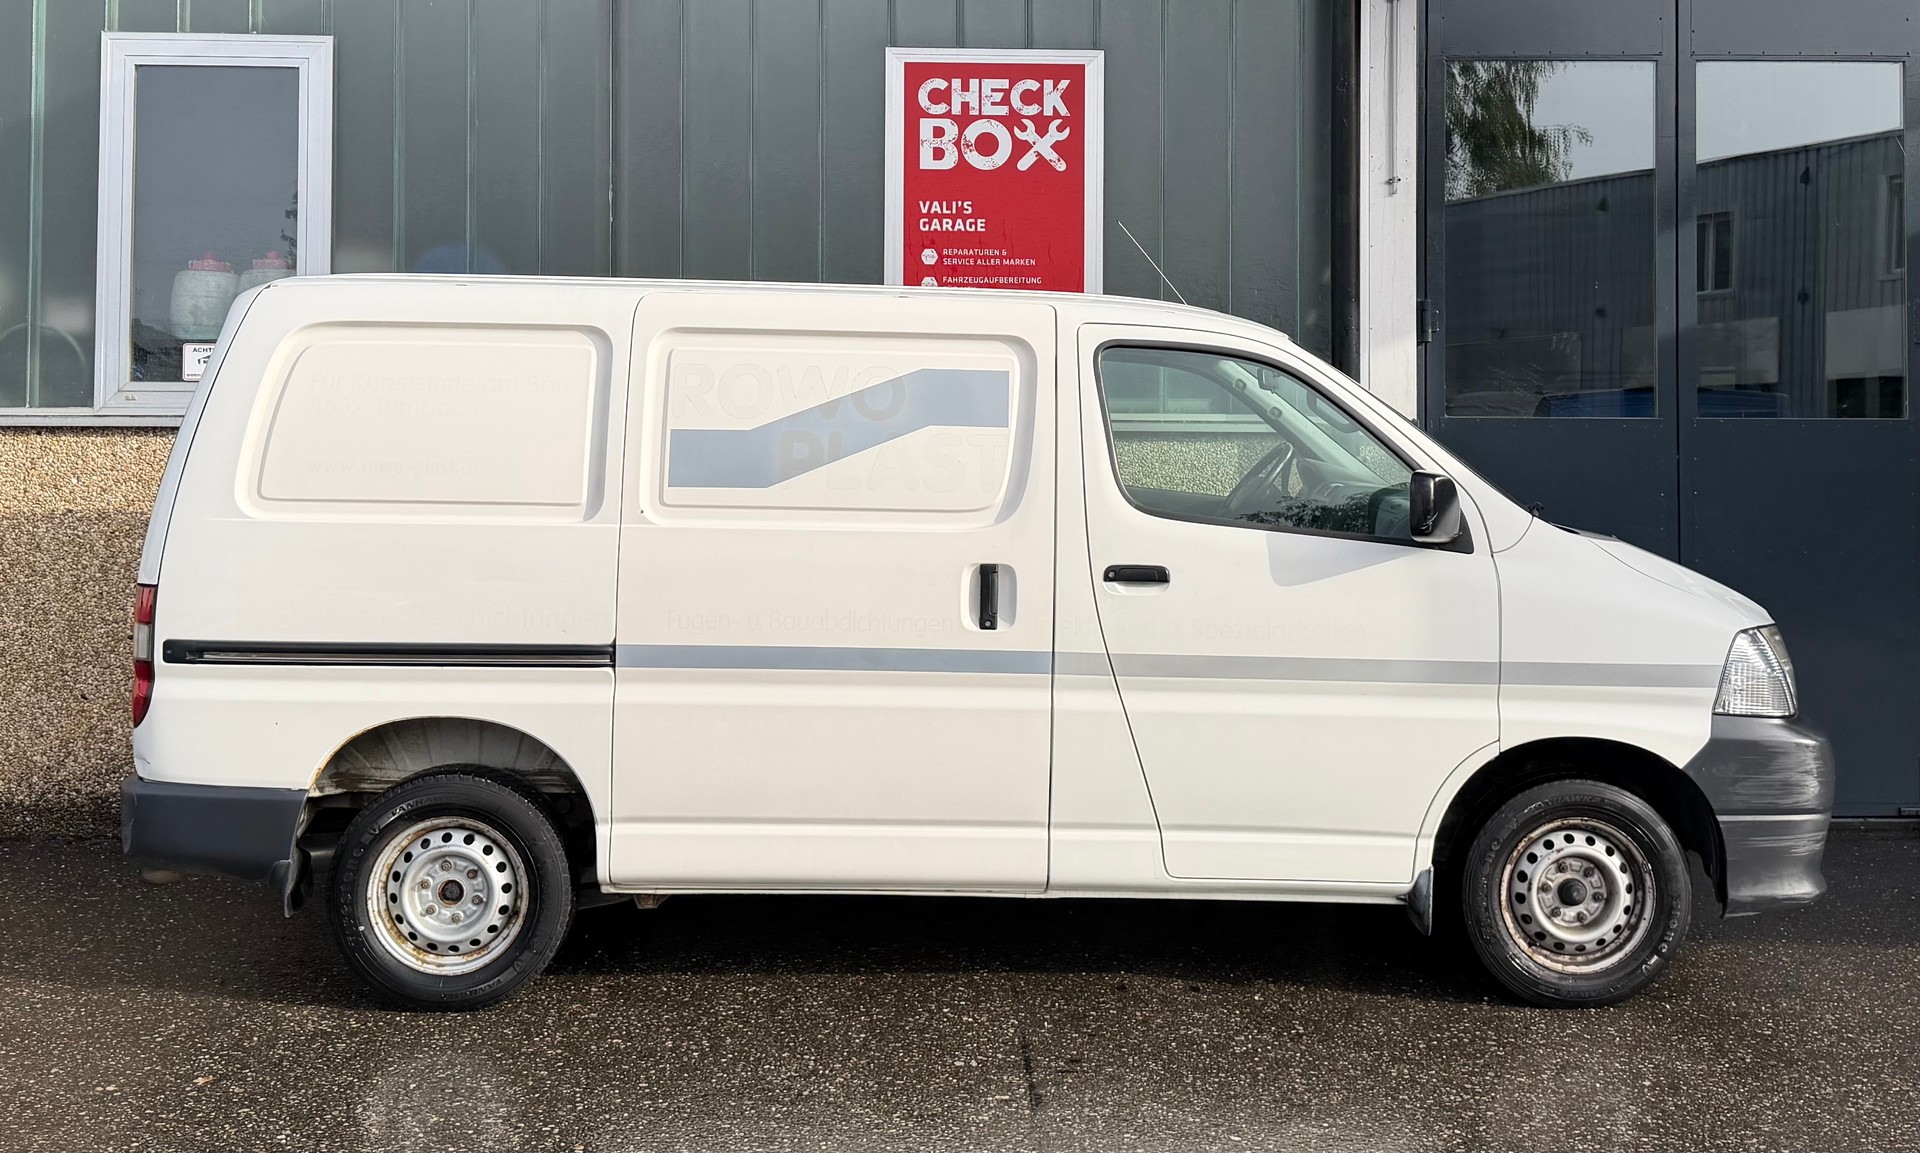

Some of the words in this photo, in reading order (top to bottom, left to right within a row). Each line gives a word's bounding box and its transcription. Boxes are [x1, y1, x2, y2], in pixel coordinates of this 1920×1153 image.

[917, 77, 1071, 117] CHECK
[919, 117, 1071, 172] BOX
[918, 200, 973, 214] VALI'S
[919, 218, 986, 232] GARAGE
[942, 248, 1000, 256] REPARATUREN
[976, 258, 1001, 266] ALLER
[1002, 258, 1036, 266] MARKEN
[942, 276, 1042, 284] FAHRZEUGAUFBEREITUNG
[672, 363, 906, 422] ROWO
[778, 430, 1010, 494] PLAST
[666, 608, 740, 636] Fugen-
[768, 609, 954, 639] Bauabdichtungen
